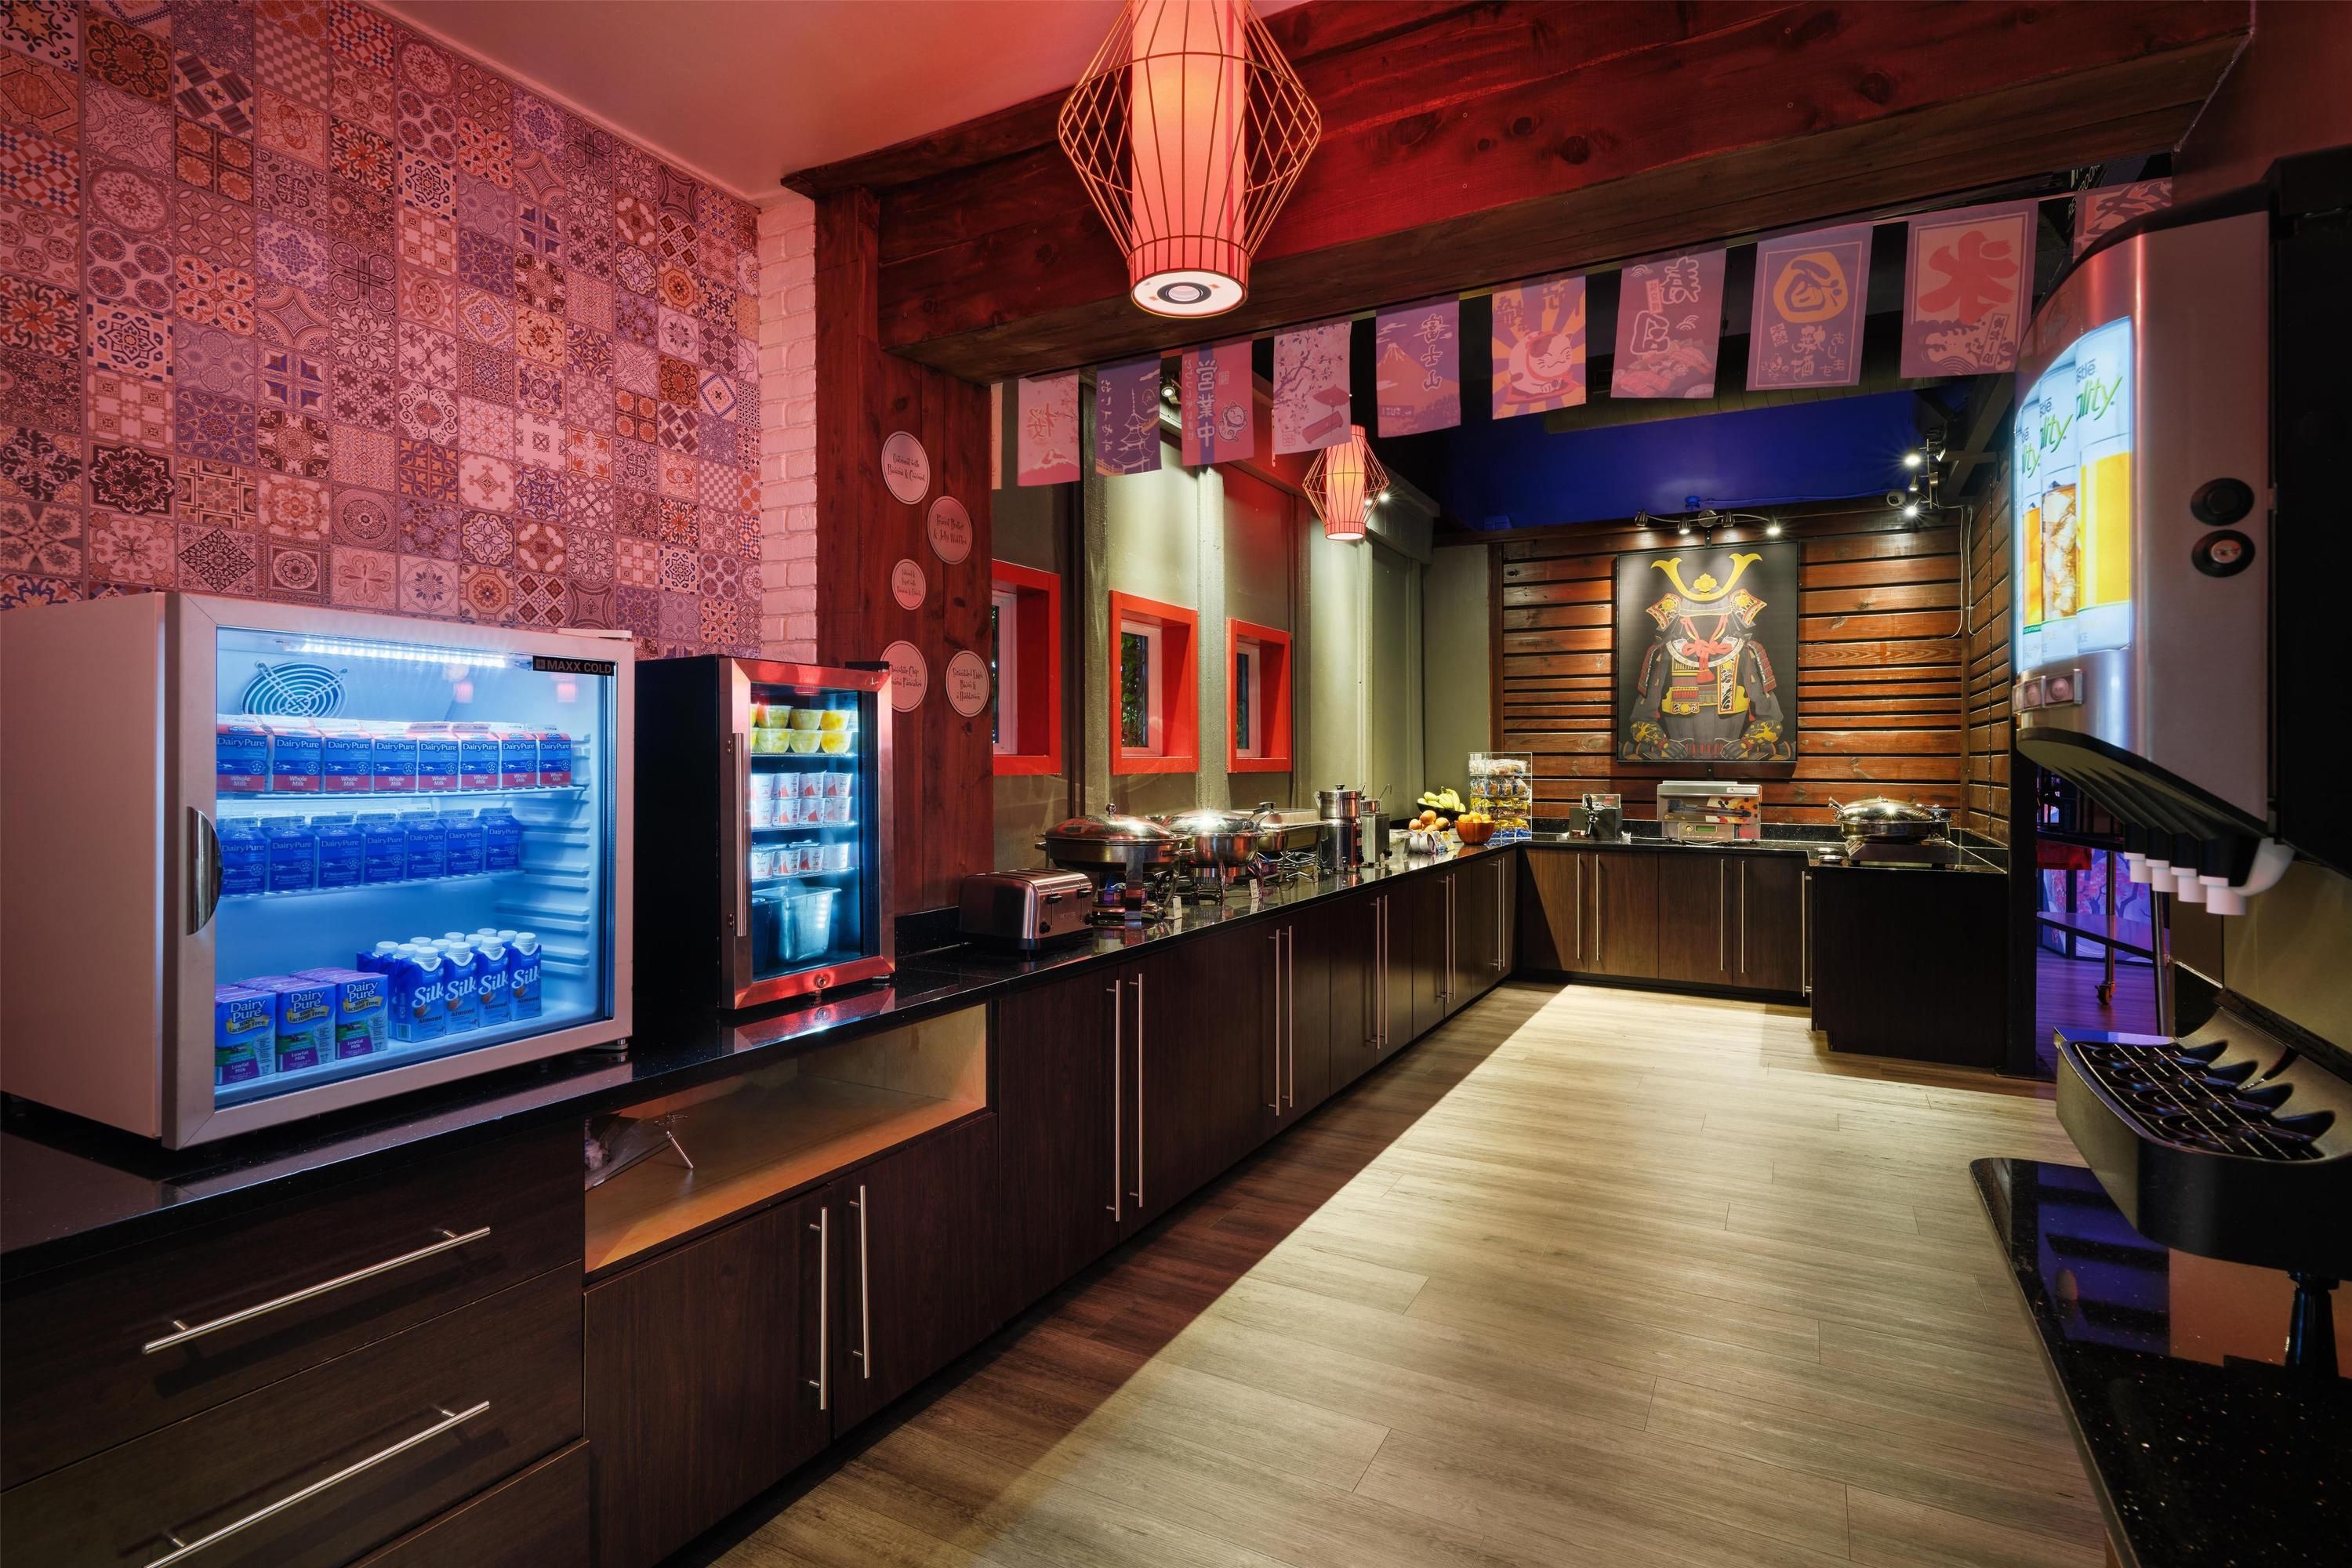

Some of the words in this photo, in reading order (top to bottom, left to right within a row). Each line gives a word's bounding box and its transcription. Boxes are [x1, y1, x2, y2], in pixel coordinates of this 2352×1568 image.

[547, 659, 581, 671] MAXX
[583, 662, 612, 673] COLD
[217, 737, 265, 748] DairyPure
[276, 739, 320, 750] DairyPure
[328, 741, 370, 750] DairyPure
[376, 742, 416, 752] DairyPure
[421, 743, 457, 752] DairyPure
[463, 743, 497, 753] DairyPure
[367, 837, 403, 845] DairyPure
[409, 833, 444, 842] DairyPure
[449, 832, 481, 840] DairyPure
[221, 844, 264, 854] DairyPure
[272, 841, 312, 850] DairyPure
[321, 840, 359, 848] DairyPure
[510, 966, 541, 989] Silk
[347, 982, 378, 993] Dairy
[478, 971, 509, 996] Silk
[445, 976, 477, 1002] Silk
[291, 991, 325, 1004] Dairy
[349, 990, 375, 1002] Pure
[412, 982, 445, 1008] Silk
[230, 1000, 267, 1013] Dairy
[293, 1000, 321, 1013] Pure
[345, 1003, 365, 1012] Lactose
[484, 1002, 508, 1011] Almond
[232, 1008, 262, 1022] Pure
[289, 1013, 312, 1022] Lactose
[451, 1008, 475, 1017] Almond
[418, 1015, 443, 1024] Almond
[229, 1022, 252, 1033] Lactose
[231, 1062, 249, 1070] Lowfat
